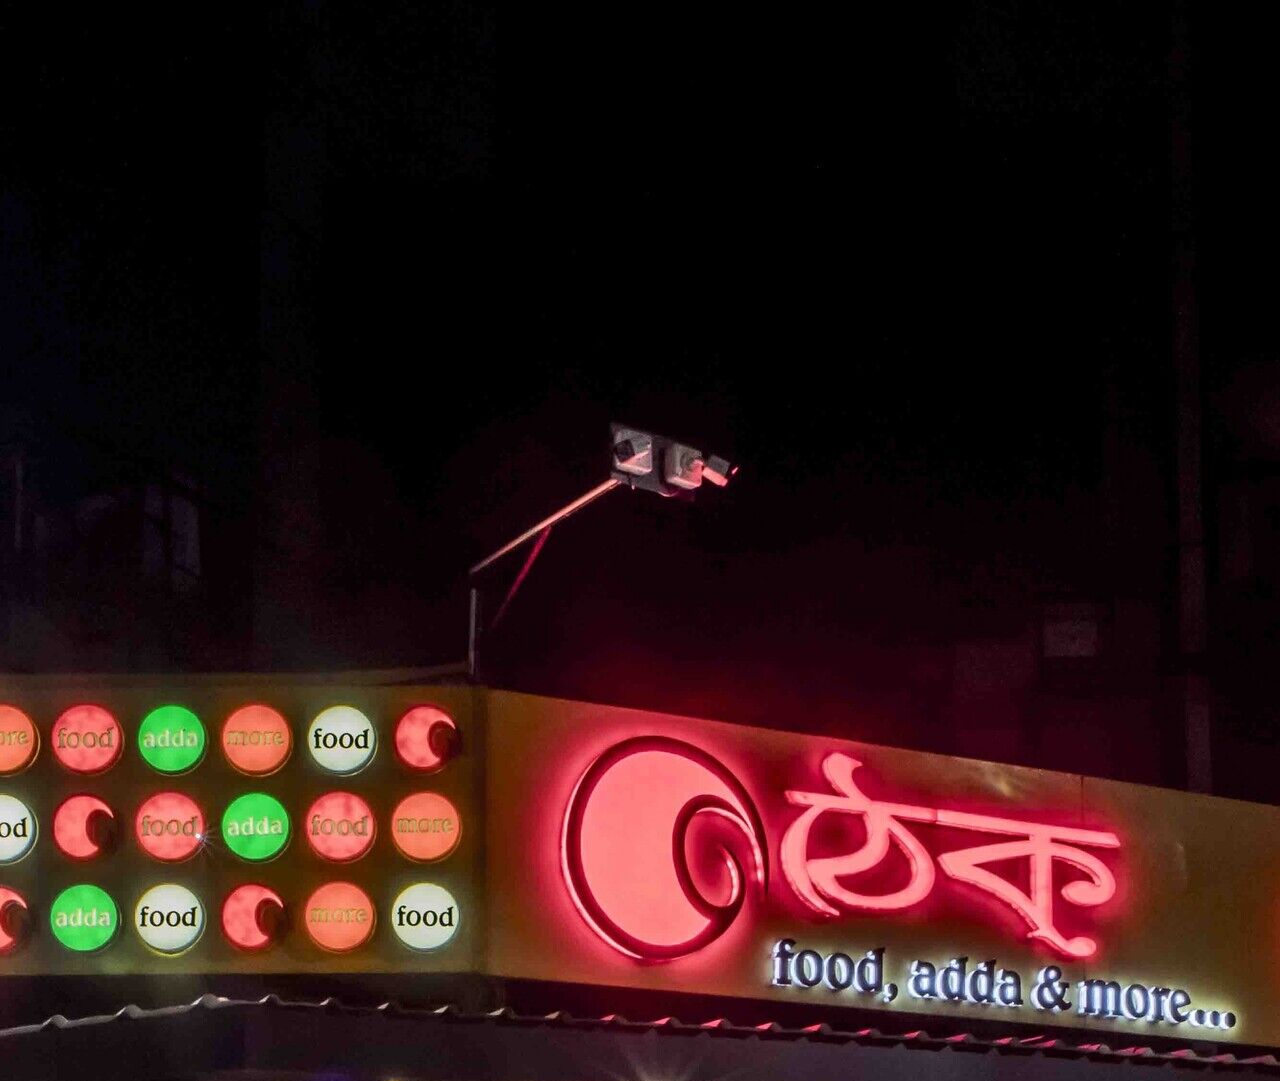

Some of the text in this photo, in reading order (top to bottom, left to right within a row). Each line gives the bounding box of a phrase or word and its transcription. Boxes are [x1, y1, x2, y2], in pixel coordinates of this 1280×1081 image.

[57, 727, 114, 749] food
[144, 729, 198, 748] adda
[227, 730, 284, 746] more
[314, 728, 369, 749] food
[142, 816, 199, 836] food
[227, 817, 283, 836] adda
[311, 816, 368, 836] food
[397, 817, 453, 834] more
[56, 908, 111, 928] adda
[140, 906, 197, 927] food
[310, 907, 367, 923] more
[398, 906, 454, 927] food
[771, 938, 899, 1002] food,
[909, 957, 1022, 1006] adda
[1031, 965, 1072, 1012] &
